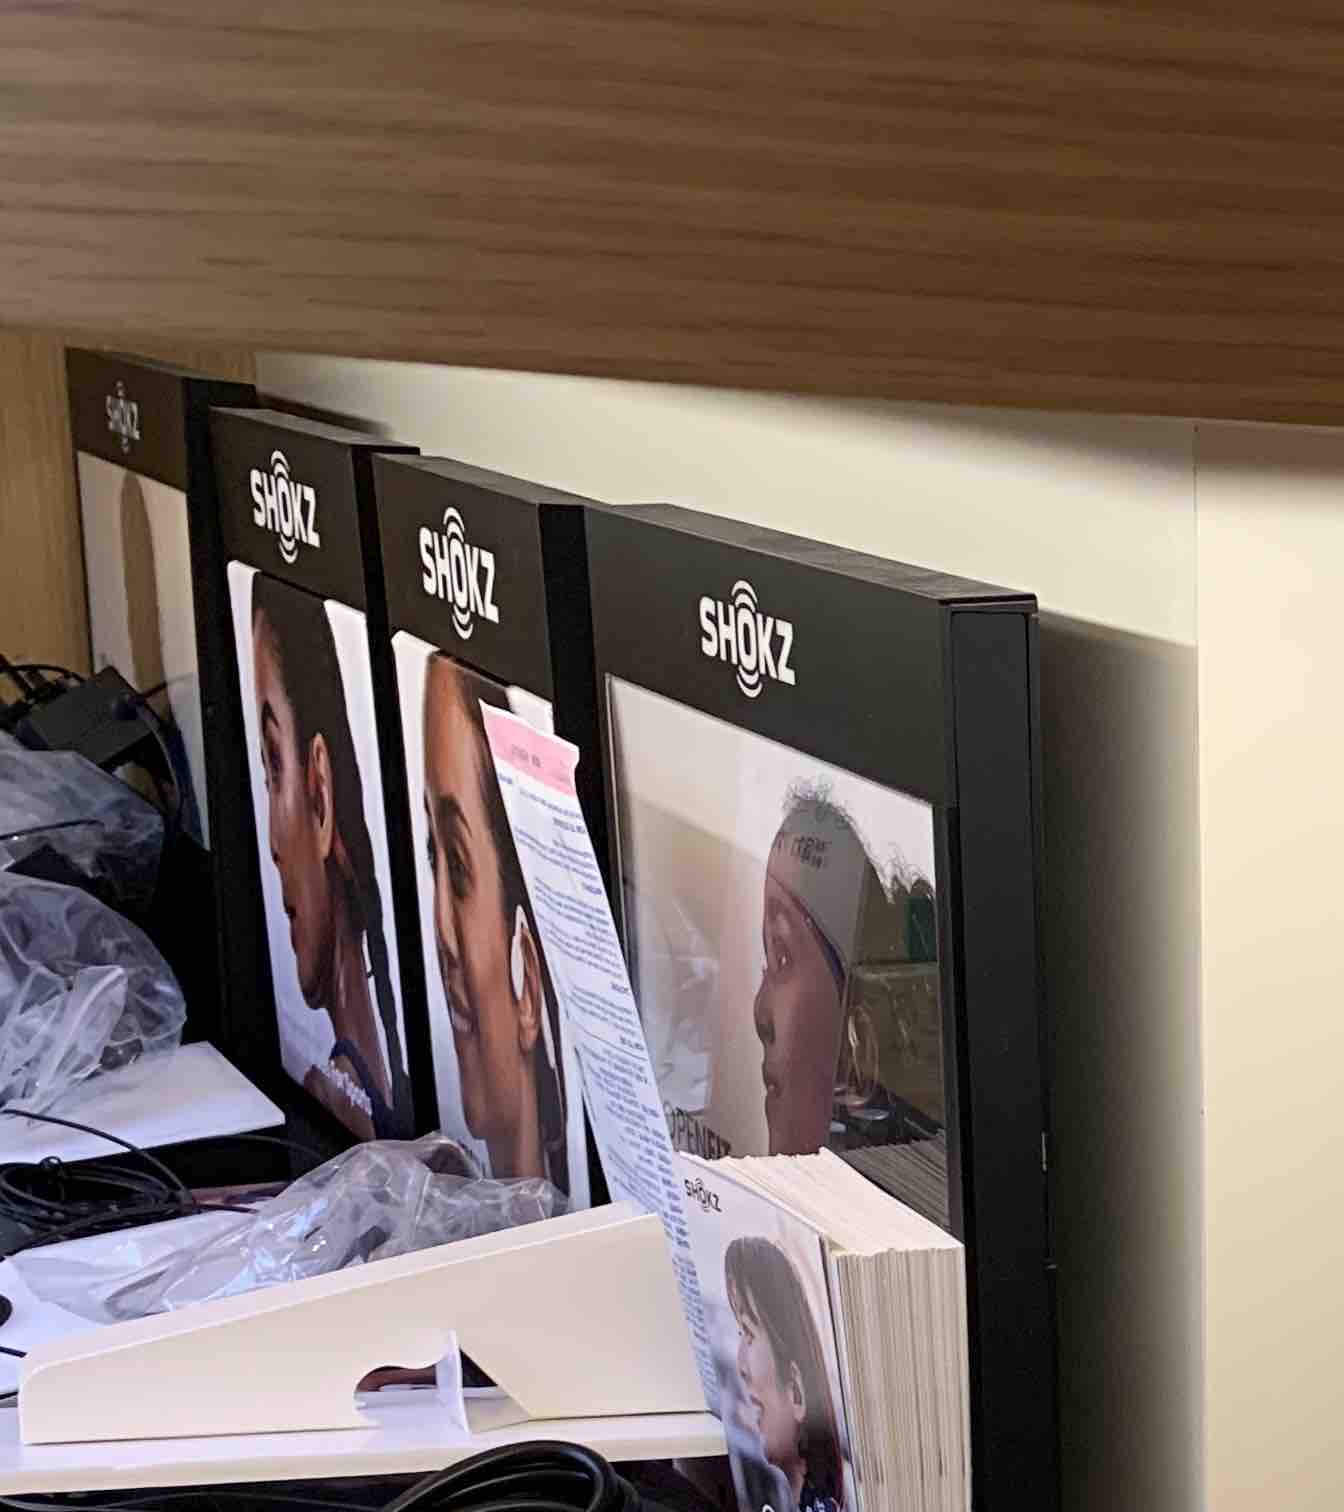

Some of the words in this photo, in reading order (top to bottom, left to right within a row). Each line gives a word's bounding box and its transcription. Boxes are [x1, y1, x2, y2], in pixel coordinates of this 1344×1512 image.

[250, 458, 321, 556] SHOKZ
[419, 516, 499, 632] SHOKZ
[700, 588, 795, 692] SHOKZ
[684, 1177, 723, 1213] SHOKZ
